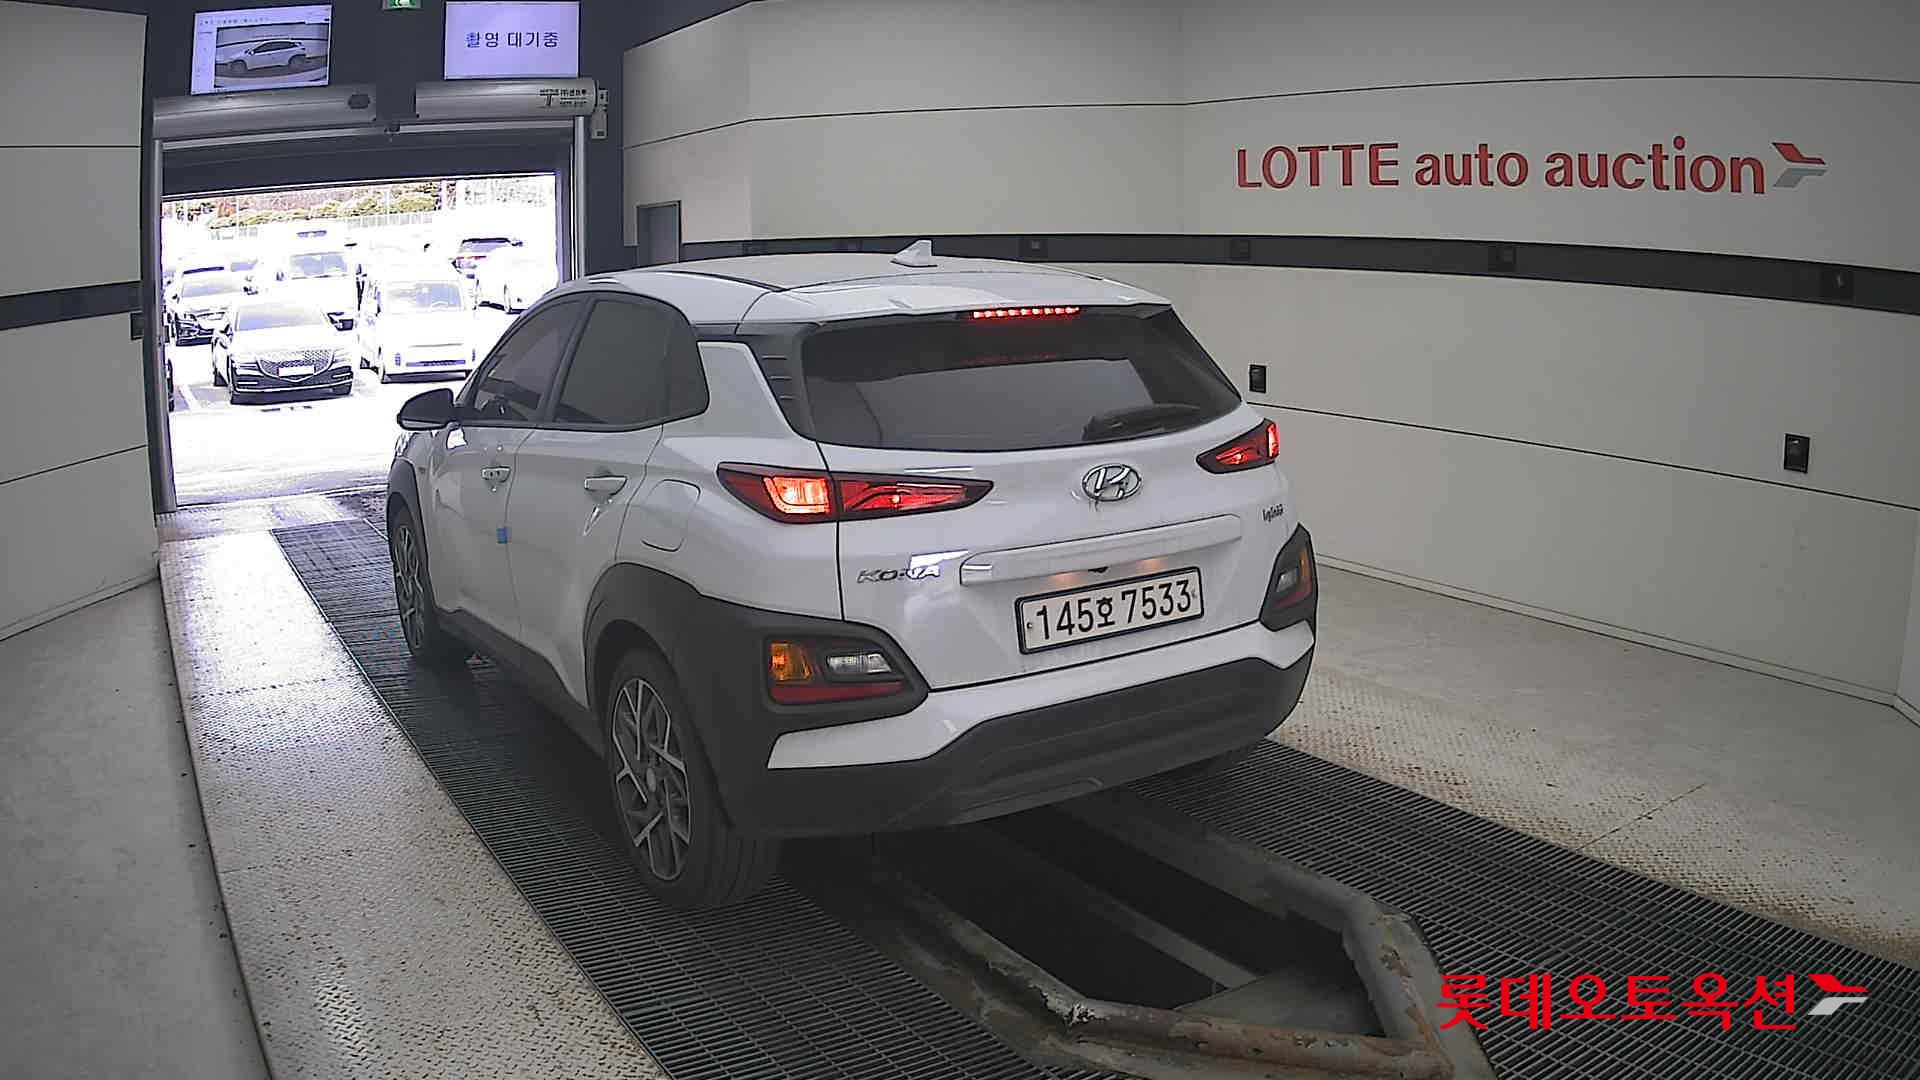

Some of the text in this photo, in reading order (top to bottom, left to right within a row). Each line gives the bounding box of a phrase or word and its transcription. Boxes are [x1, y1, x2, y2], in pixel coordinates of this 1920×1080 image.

[507, 31, 559, 48] 대기중
[1237, 136, 1766, 194] LOTTE auto auction
[1036, 579, 1191, 640] 145호 7533
